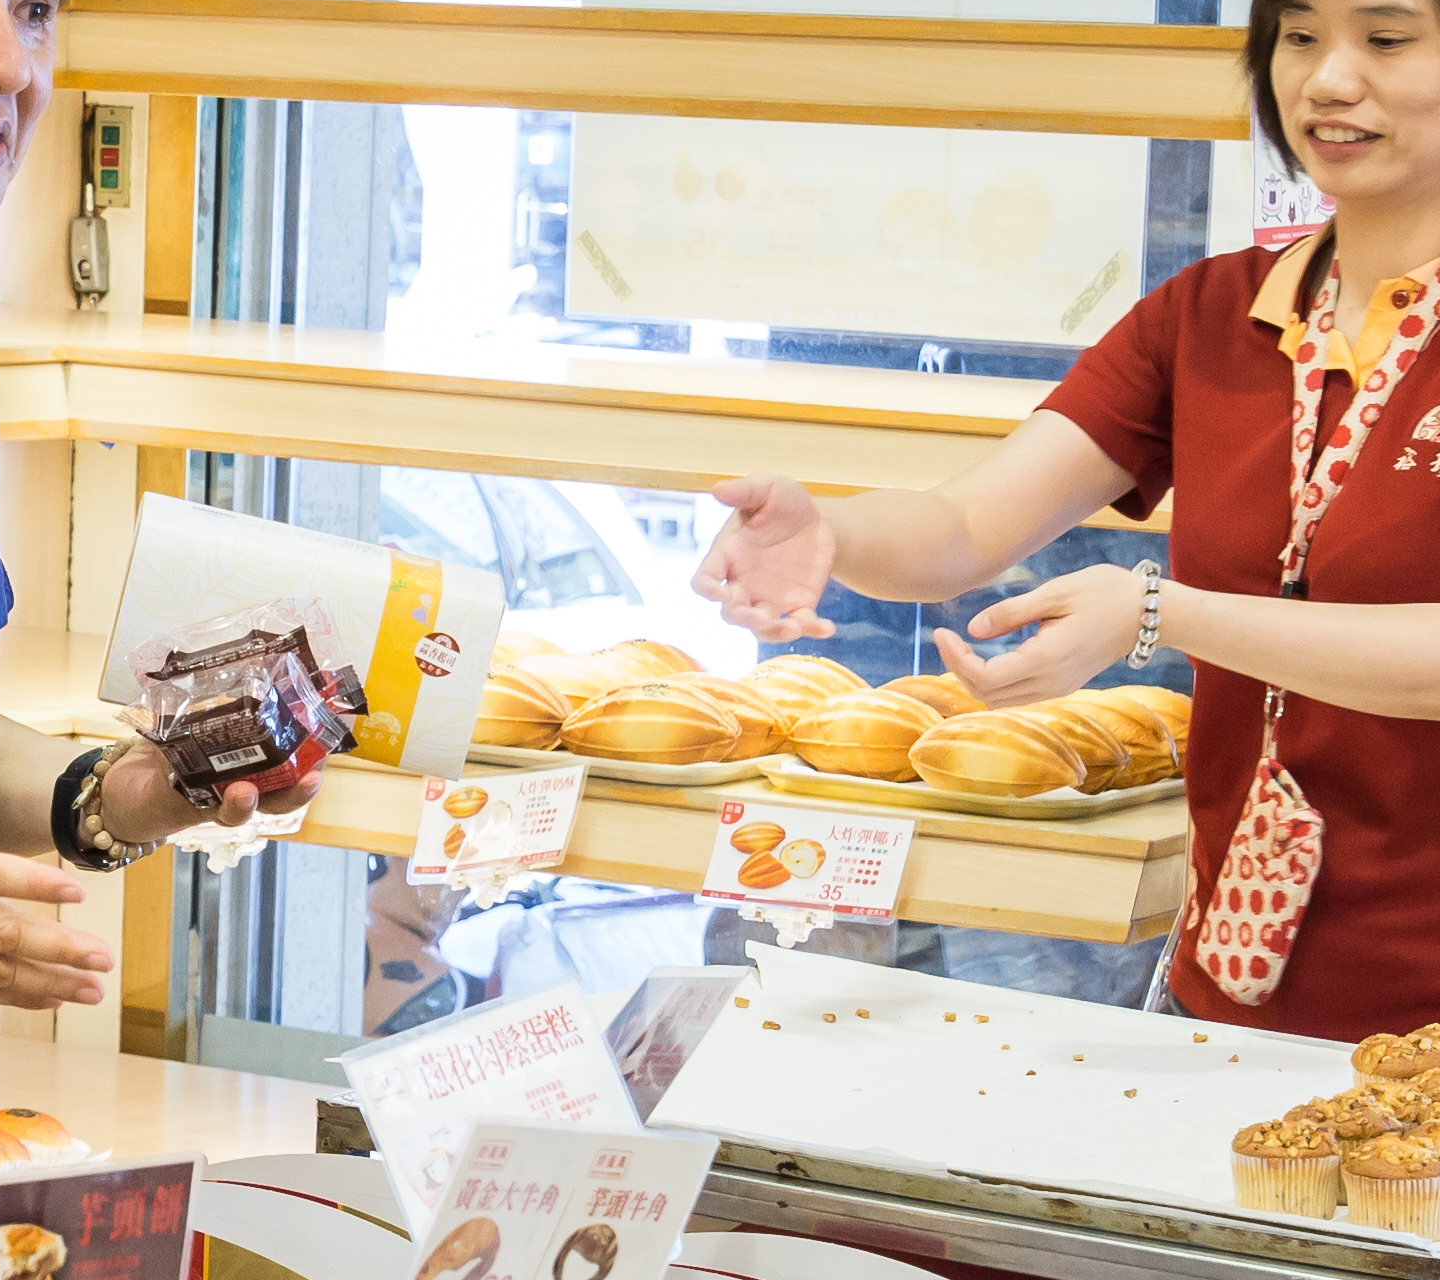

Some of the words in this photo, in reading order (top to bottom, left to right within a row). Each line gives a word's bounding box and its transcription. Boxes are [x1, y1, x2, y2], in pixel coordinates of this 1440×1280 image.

[825, 825, 904, 847] 大炸彈椰子
[818, 884, 844, 901] 35
[415, 1003, 585, 1103] 蔥花肉鬆蛋糕
[79, 1182, 187, 1248] 芋頭餅
[451, 1178, 561, 1216] 黃金大牛角
[586, 1186, 669, 1223] 芋頭牛角
